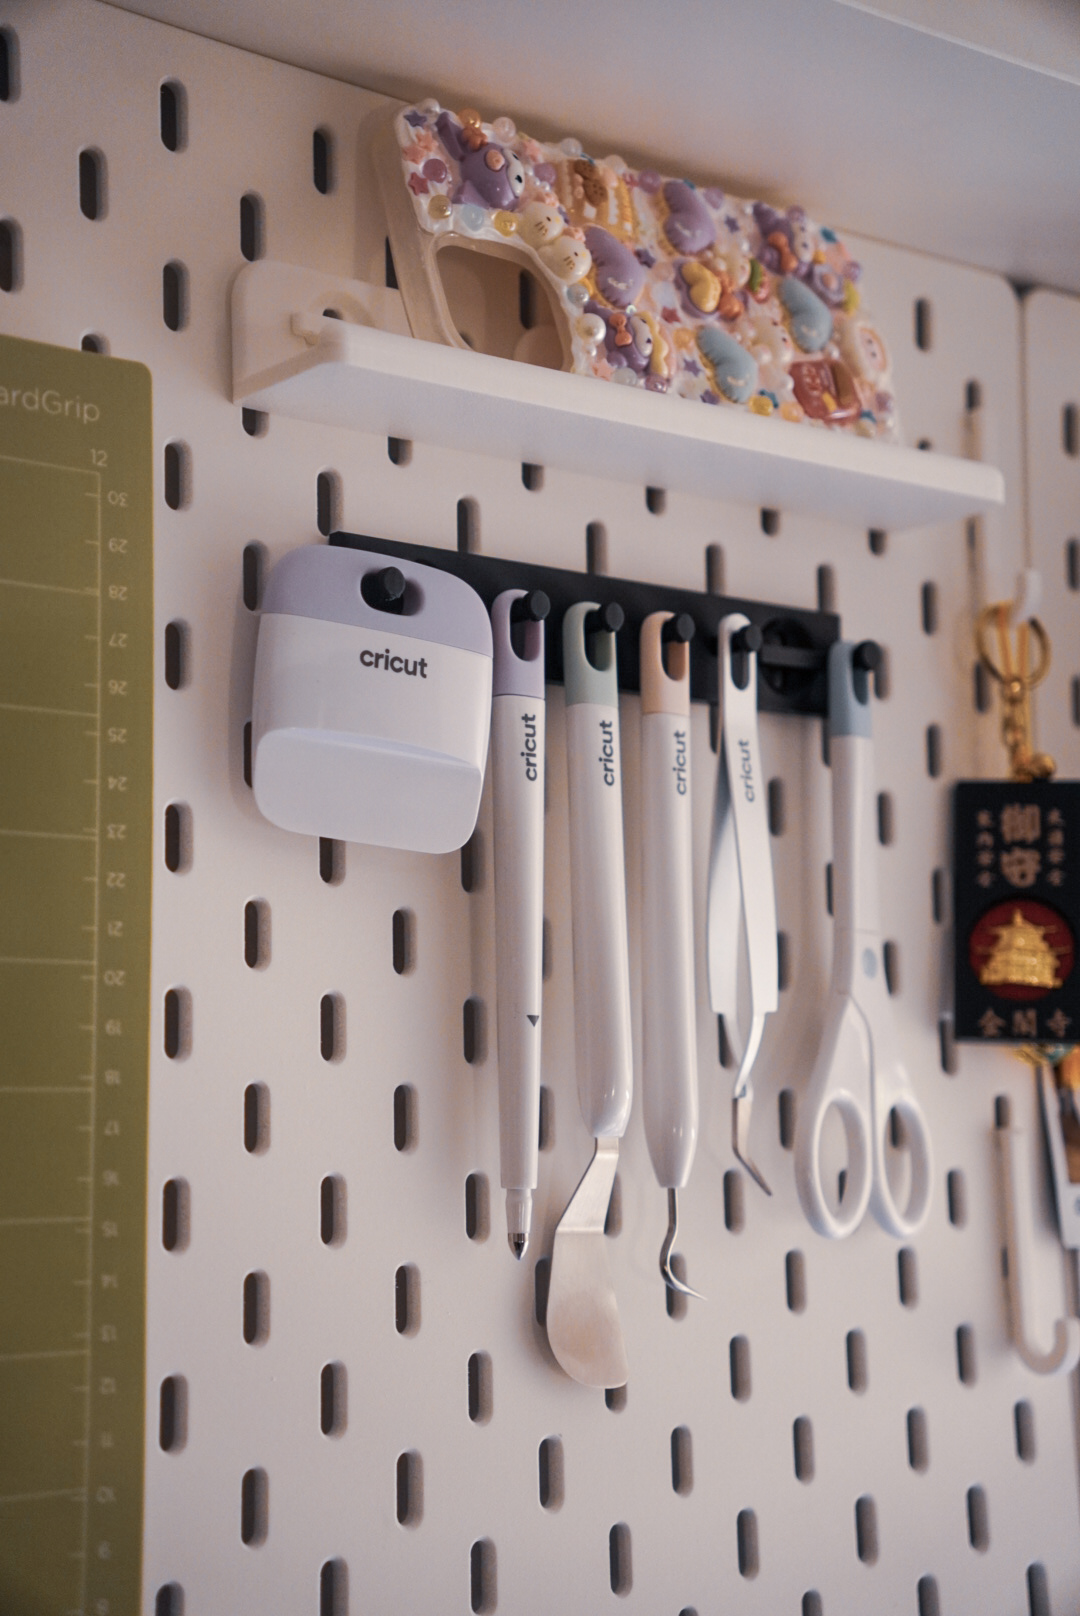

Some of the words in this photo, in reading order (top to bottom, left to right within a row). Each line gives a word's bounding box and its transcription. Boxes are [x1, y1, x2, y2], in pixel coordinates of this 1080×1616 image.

[90, 448, 108, 467] 12
[359, 648, 428, 679] cricut
[520, 713, 537, 781] cricut
[599, 720, 615, 787] cricut
[672, 730, 688, 796] cricut
[735, 739, 756, 803] cricut
